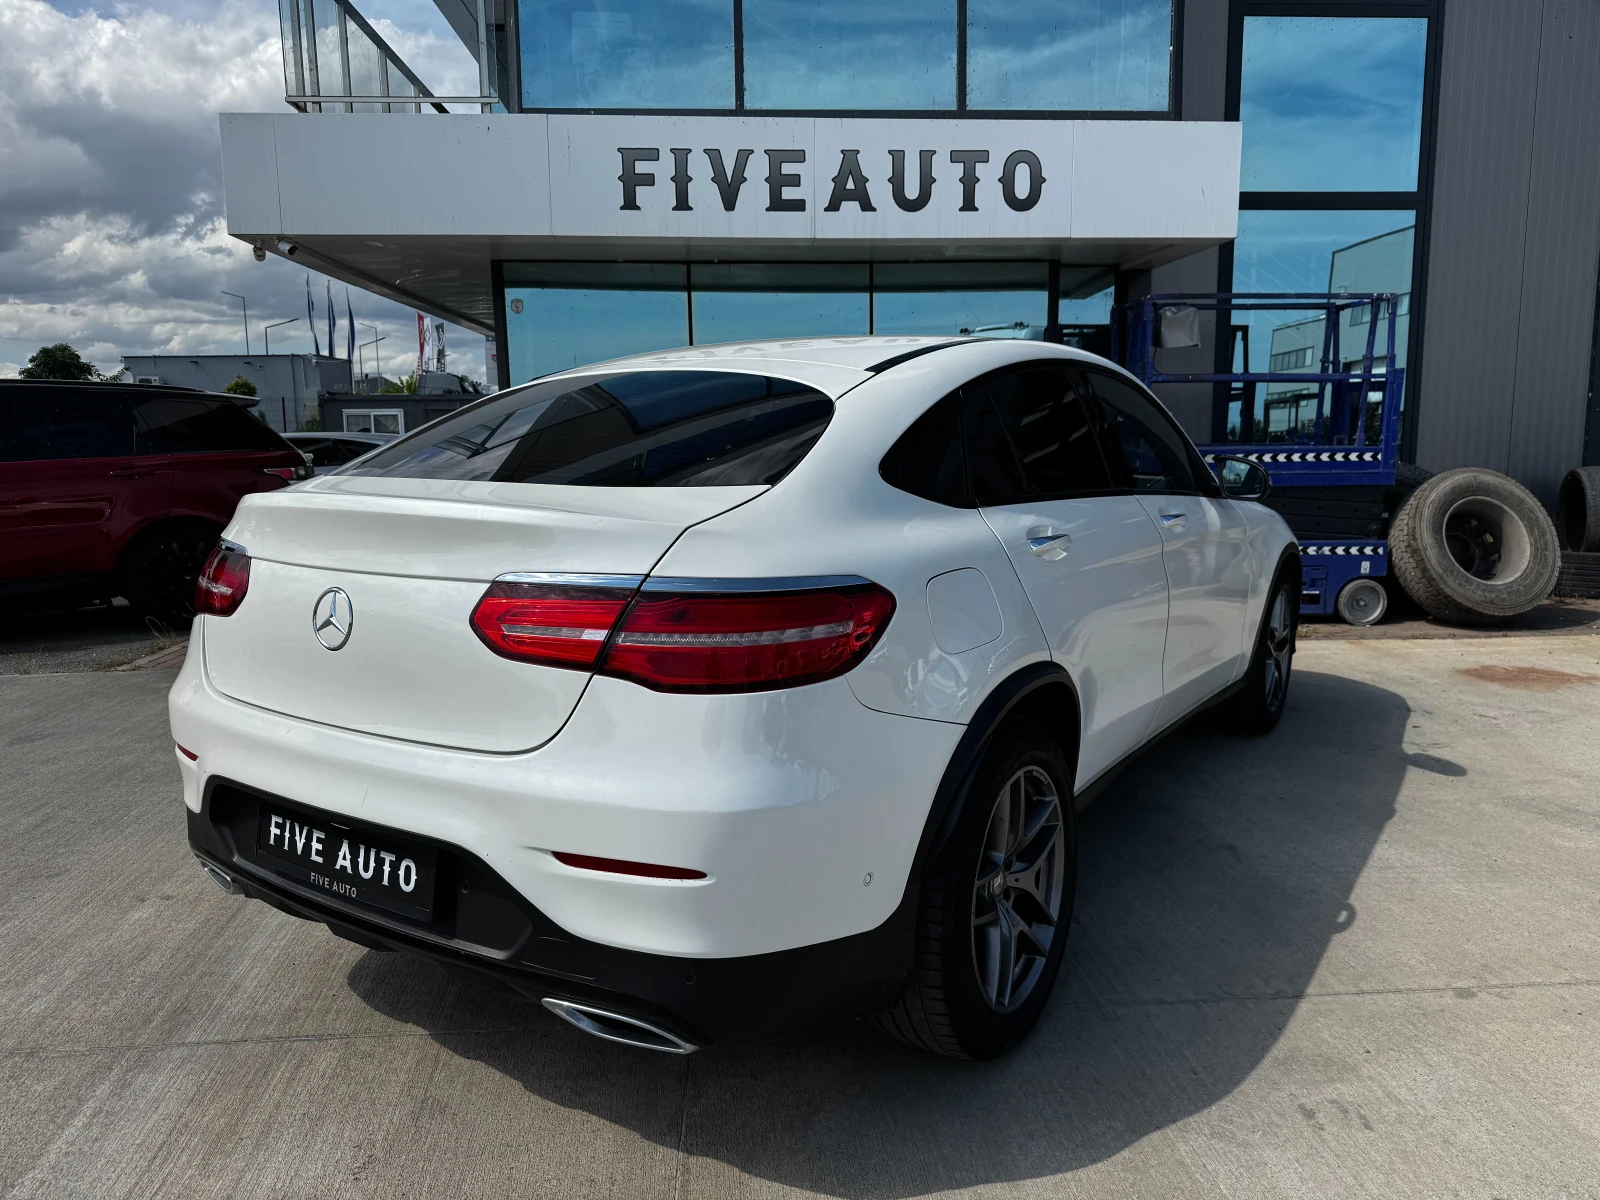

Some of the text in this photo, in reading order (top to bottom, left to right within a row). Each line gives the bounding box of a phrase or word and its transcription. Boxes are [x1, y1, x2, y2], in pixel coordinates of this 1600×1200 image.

[617, 147, 1047, 213] FIVE AUTO
[269, 813, 418, 893] FIVE AUTO
[310, 872, 357, 898] FIVE AUTO
